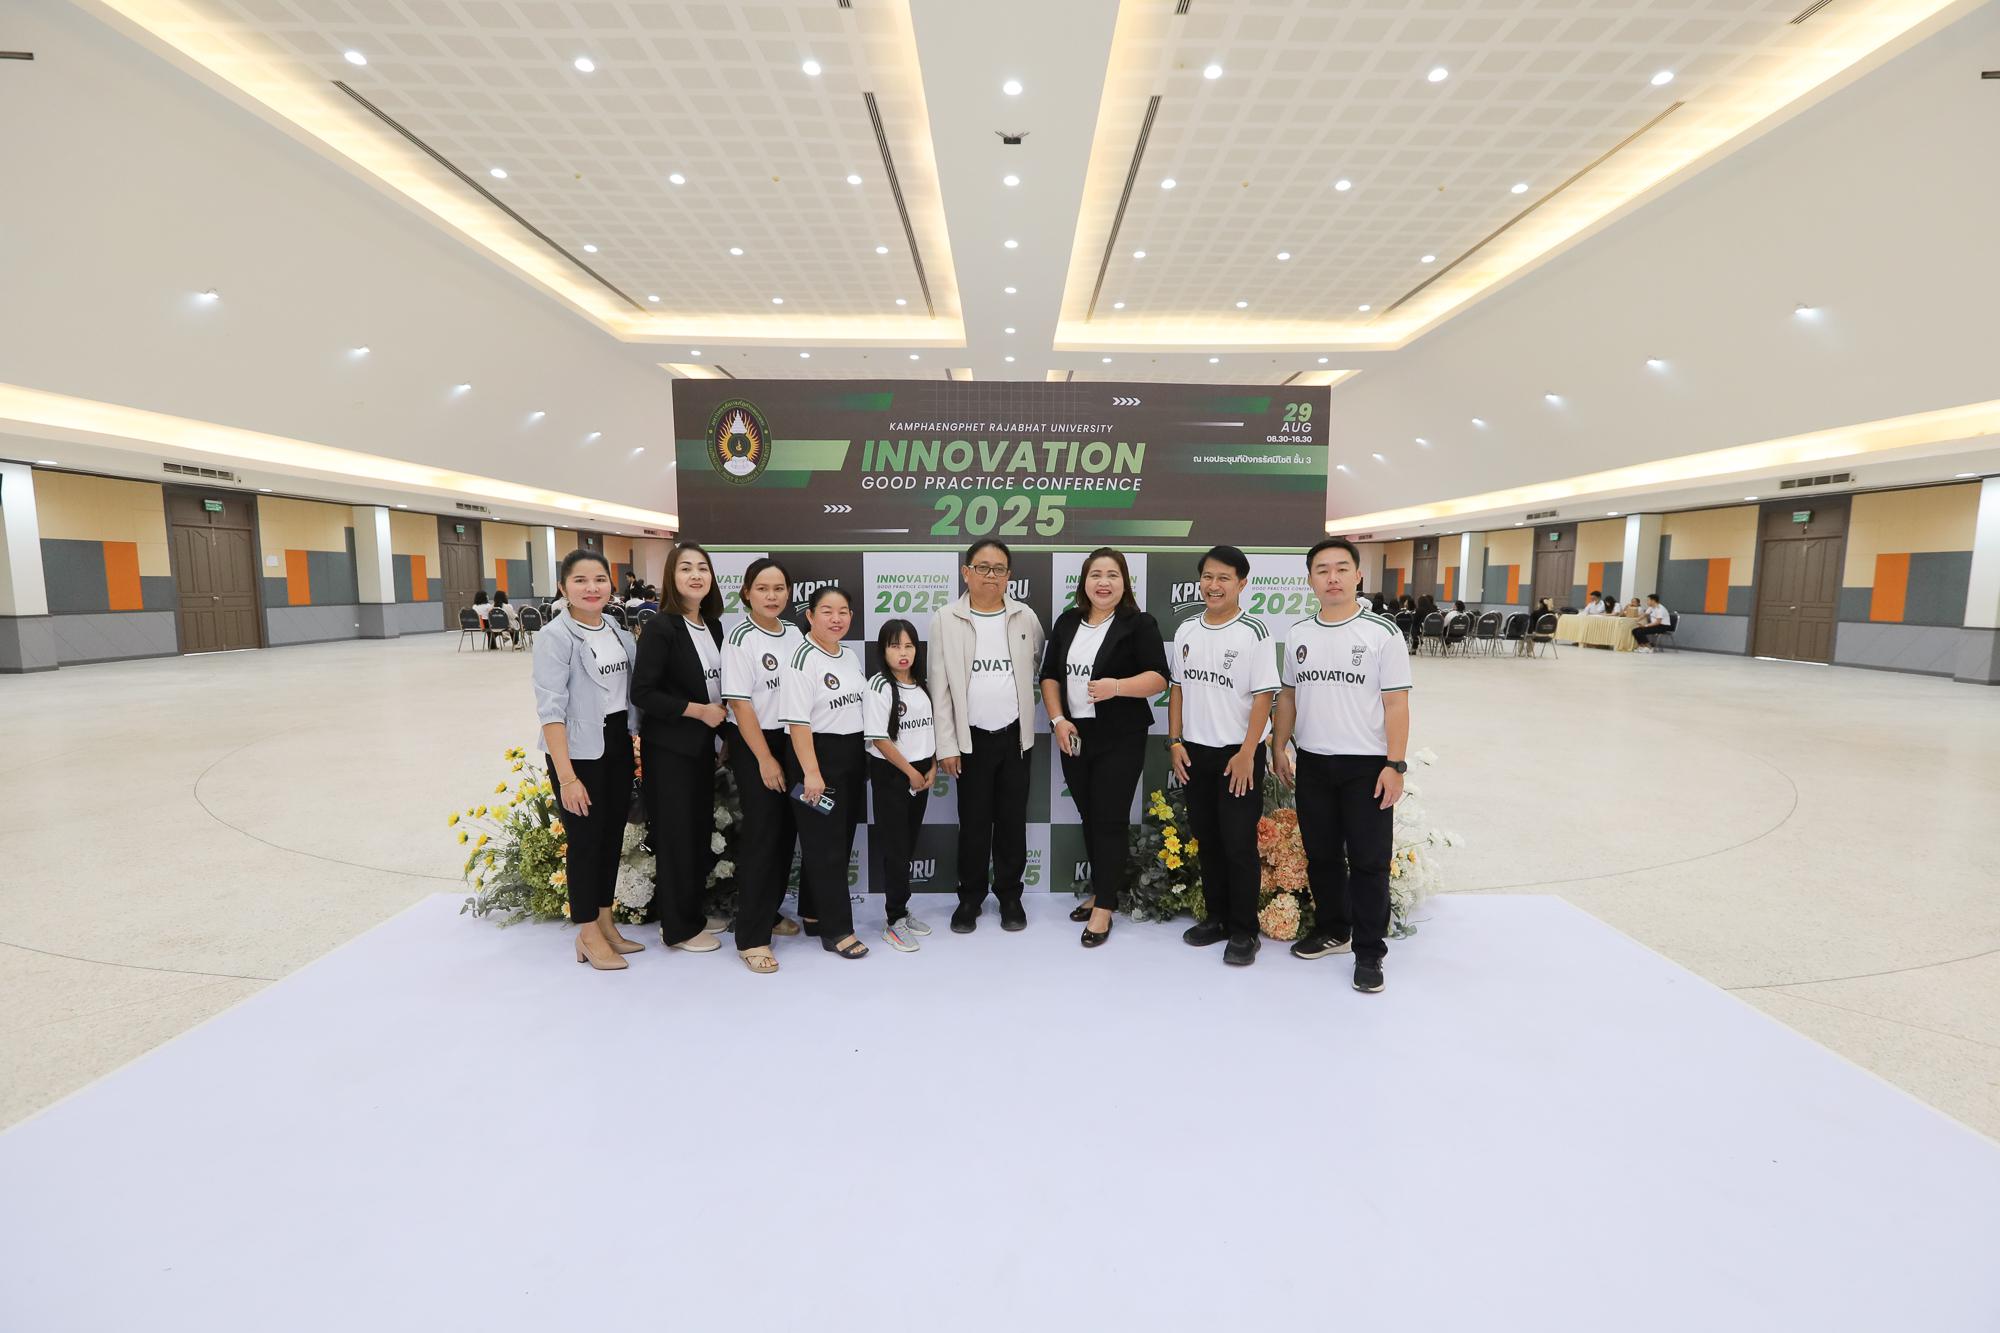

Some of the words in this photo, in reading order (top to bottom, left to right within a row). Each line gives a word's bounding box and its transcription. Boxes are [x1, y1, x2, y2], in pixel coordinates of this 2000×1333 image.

[1283, 402, 1313, 422] 29
[889, 422, 985, 431] KAMPHAENGPHET
[989, 423, 1046, 432] RAJABHAT
[1050, 424, 1114, 433] UNIVERSITY
[1281, 422, 1312, 432] AUG
[861, 440, 1146, 474] INNOVATION
[1306, 456, 1312, 464] 3
[861, 476, 917, 490] GOOD
[924, 476, 1015, 490] PRACTICE
[1022, 476, 1143, 491] CONFERENCE
[930, 495, 1067, 537] 2025
[876, 574, 950, 583] INNOVATION
[1251, 576, 1306, 585] INNOVATI
[1006, 579, 1029, 599] RU
[1171, 581, 1205, 603] KPR
[874, 591, 950, 613] 2025
[1248, 592, 1321, 615] 2025
[598, 660, 628, 675] NOVATI
[898, 717, 933, 730] NNOVATI
[909, 858, 936, 879] RU
